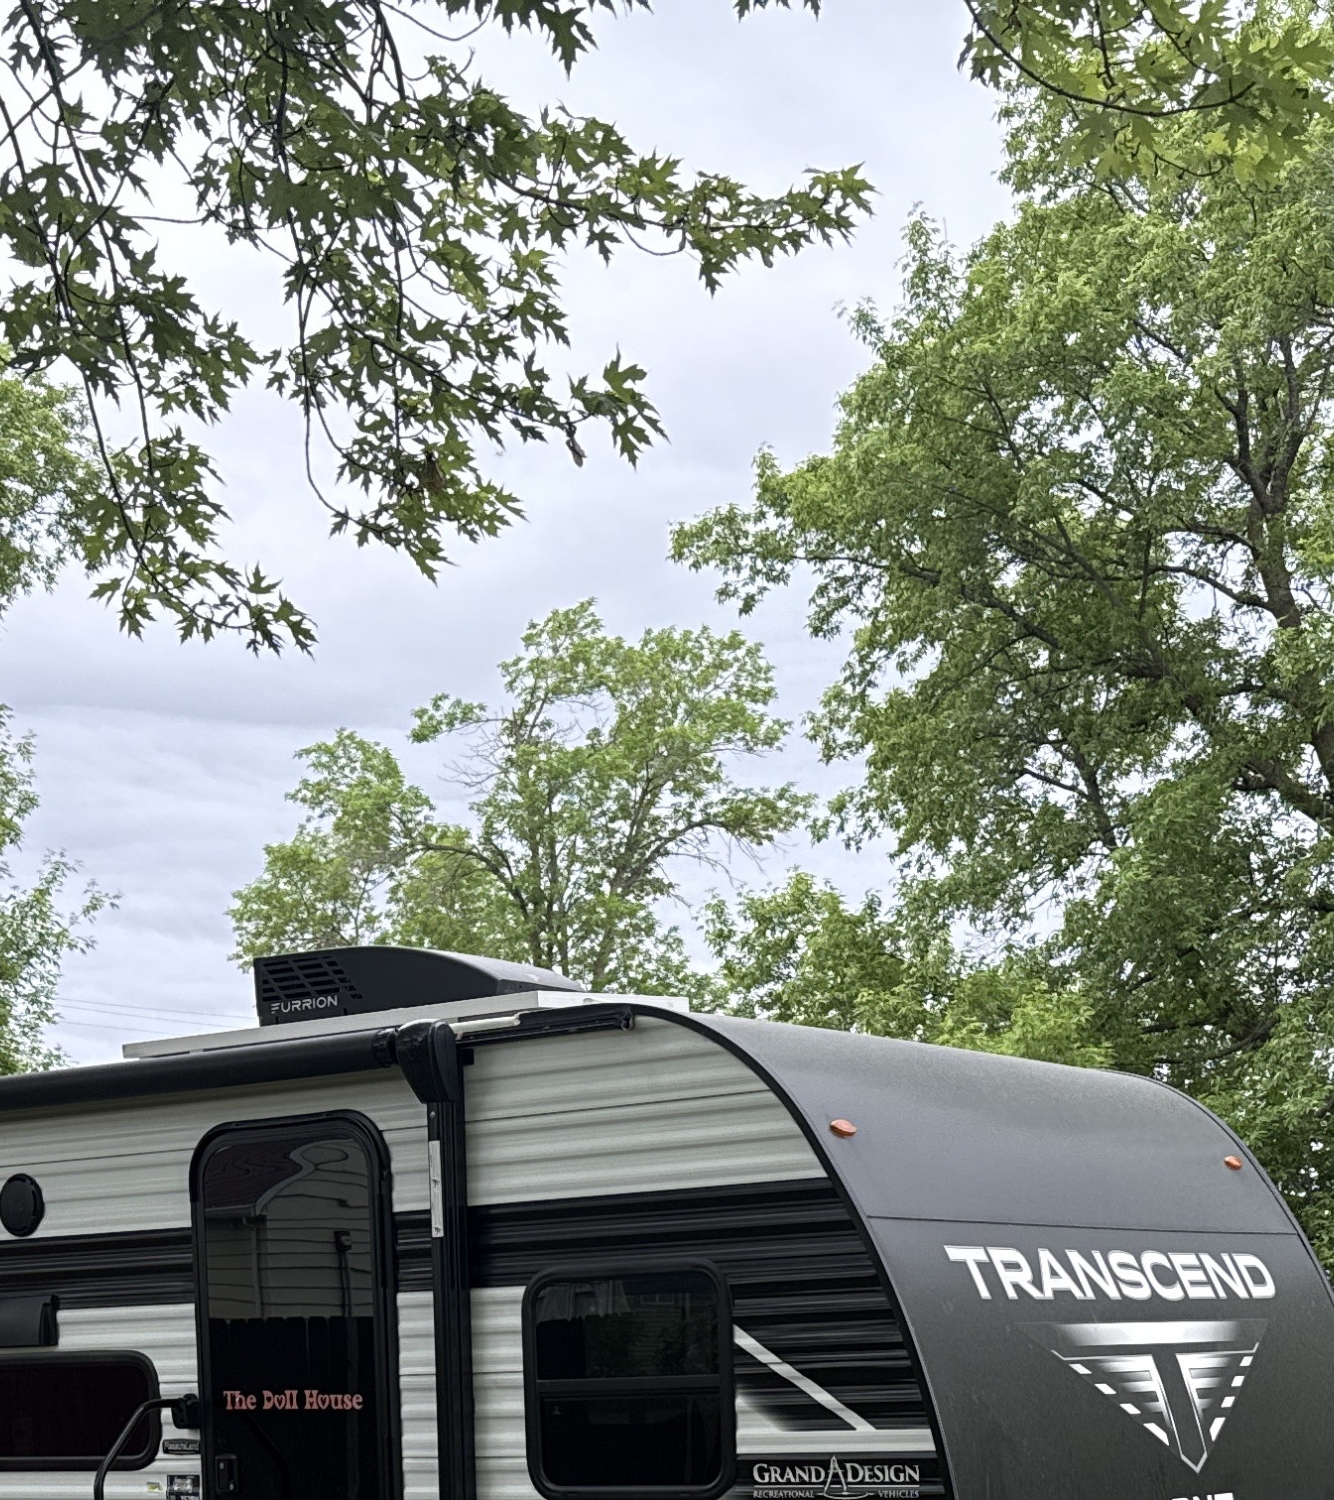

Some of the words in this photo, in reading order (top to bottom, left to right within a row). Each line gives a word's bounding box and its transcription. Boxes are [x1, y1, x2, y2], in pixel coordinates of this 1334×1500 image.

[271, 995, 338, 1015] FURRION
[943, 1245, 1276, 1301] TRANSCEND
[223, 1390, 257, 1411] The
[262, 1390, 299, 1411] Doll
[304, 1390, 364, 1411] House
[753, 1463, 825, 1483] GRAND
[845, 1463, 920, 1483] DESIGN
[753, 1489, 815, 1499] RECREATIONAL
[877, 1489, 920, 1499] VEHICLES
